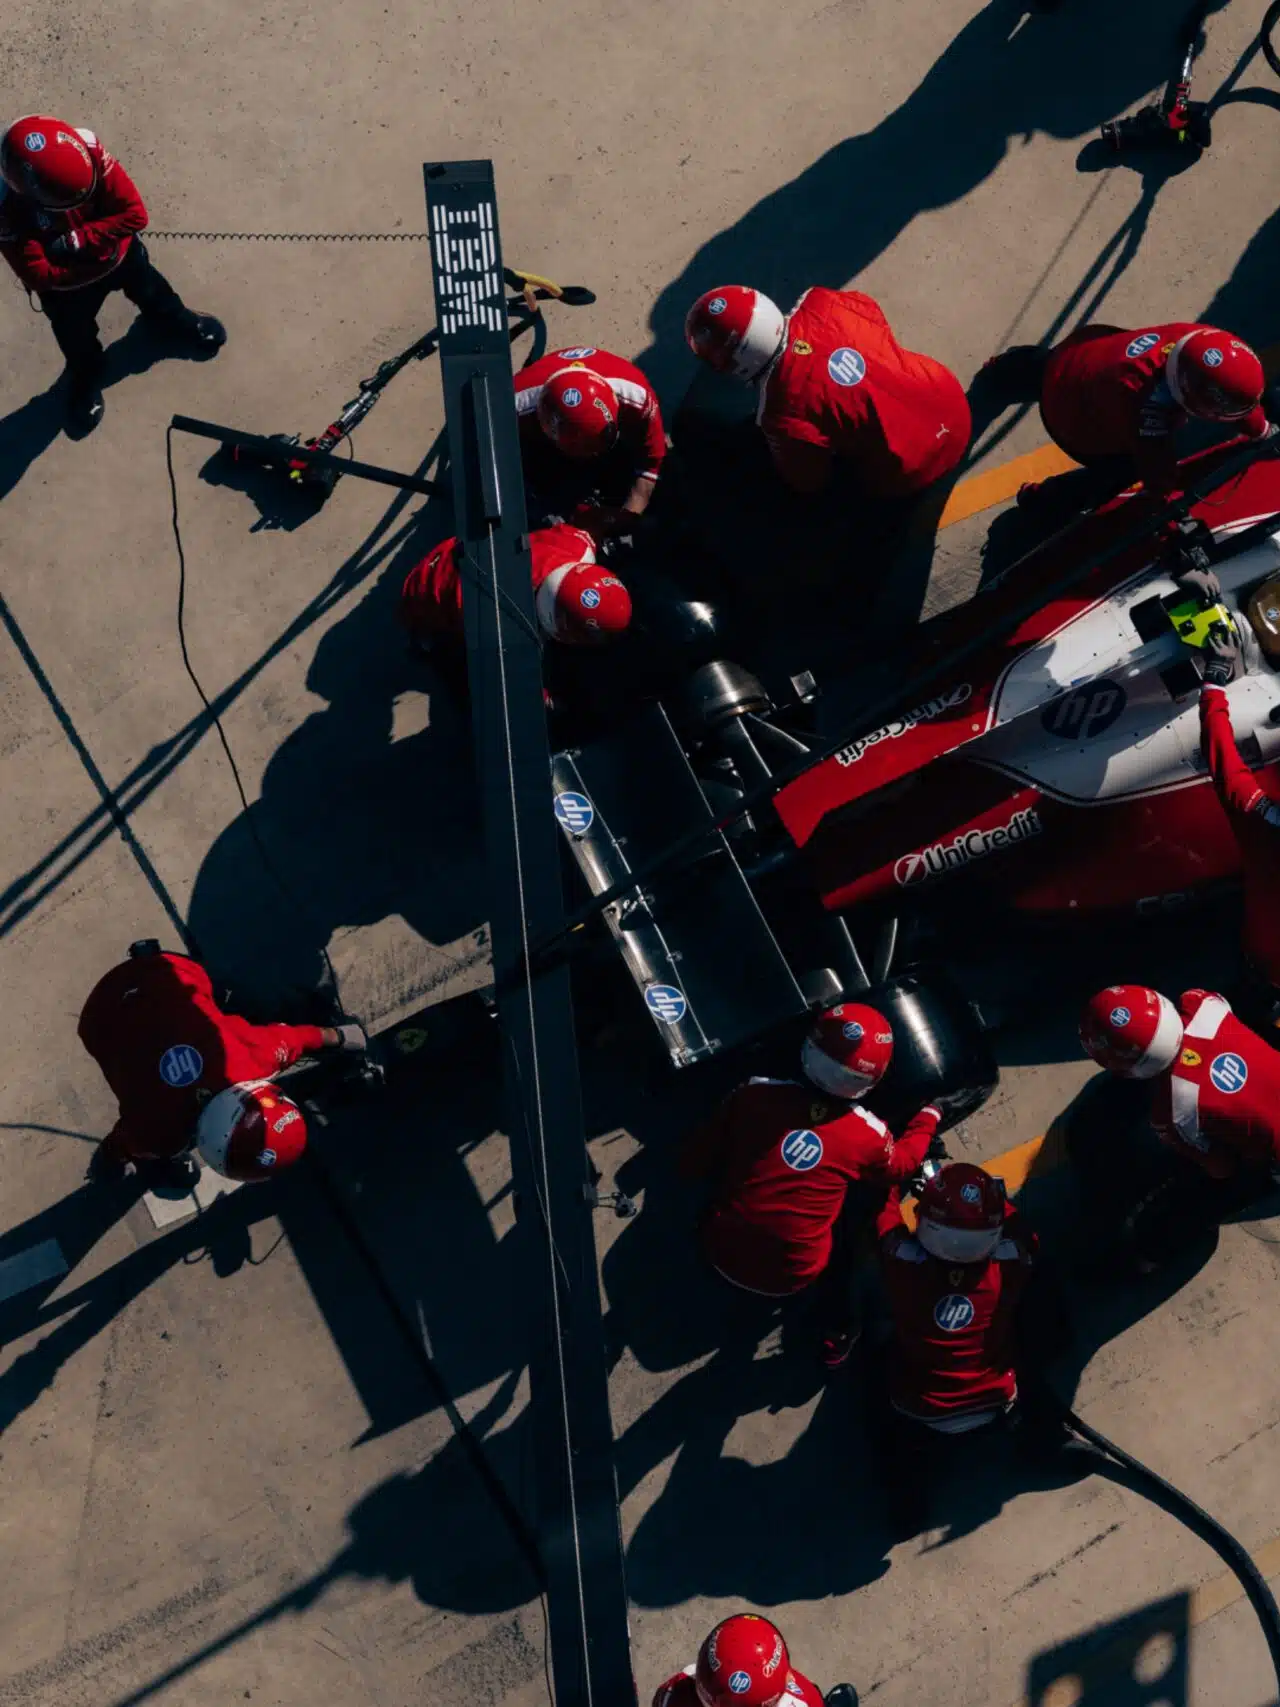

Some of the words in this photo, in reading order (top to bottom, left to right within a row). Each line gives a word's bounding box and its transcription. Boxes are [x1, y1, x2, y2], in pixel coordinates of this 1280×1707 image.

[432, 203, 501, 334] IBM
[1127, 334, 1160, 358] hp
[829, 348, 866, 386] hp
[834, 690, 952, 767] UniCredit
[1044, 681, 1126, 740] hp
[554, 793, 593, 833] hp
[923, 807, 1041, 876] UniCredit
[646, 985, 686, 1023] hp
[1109, 1007, 1131, 1027] hp
[160, 1045, 202, 1087] hp
[1210, 1052, 1248, 1094] hp
[782, 1129, 823, 1170] hp
[961, 1184, 980, 1203] hp
[935, 1295, 974, 1332] hp
[728, 1671, 751, 1694] hp
